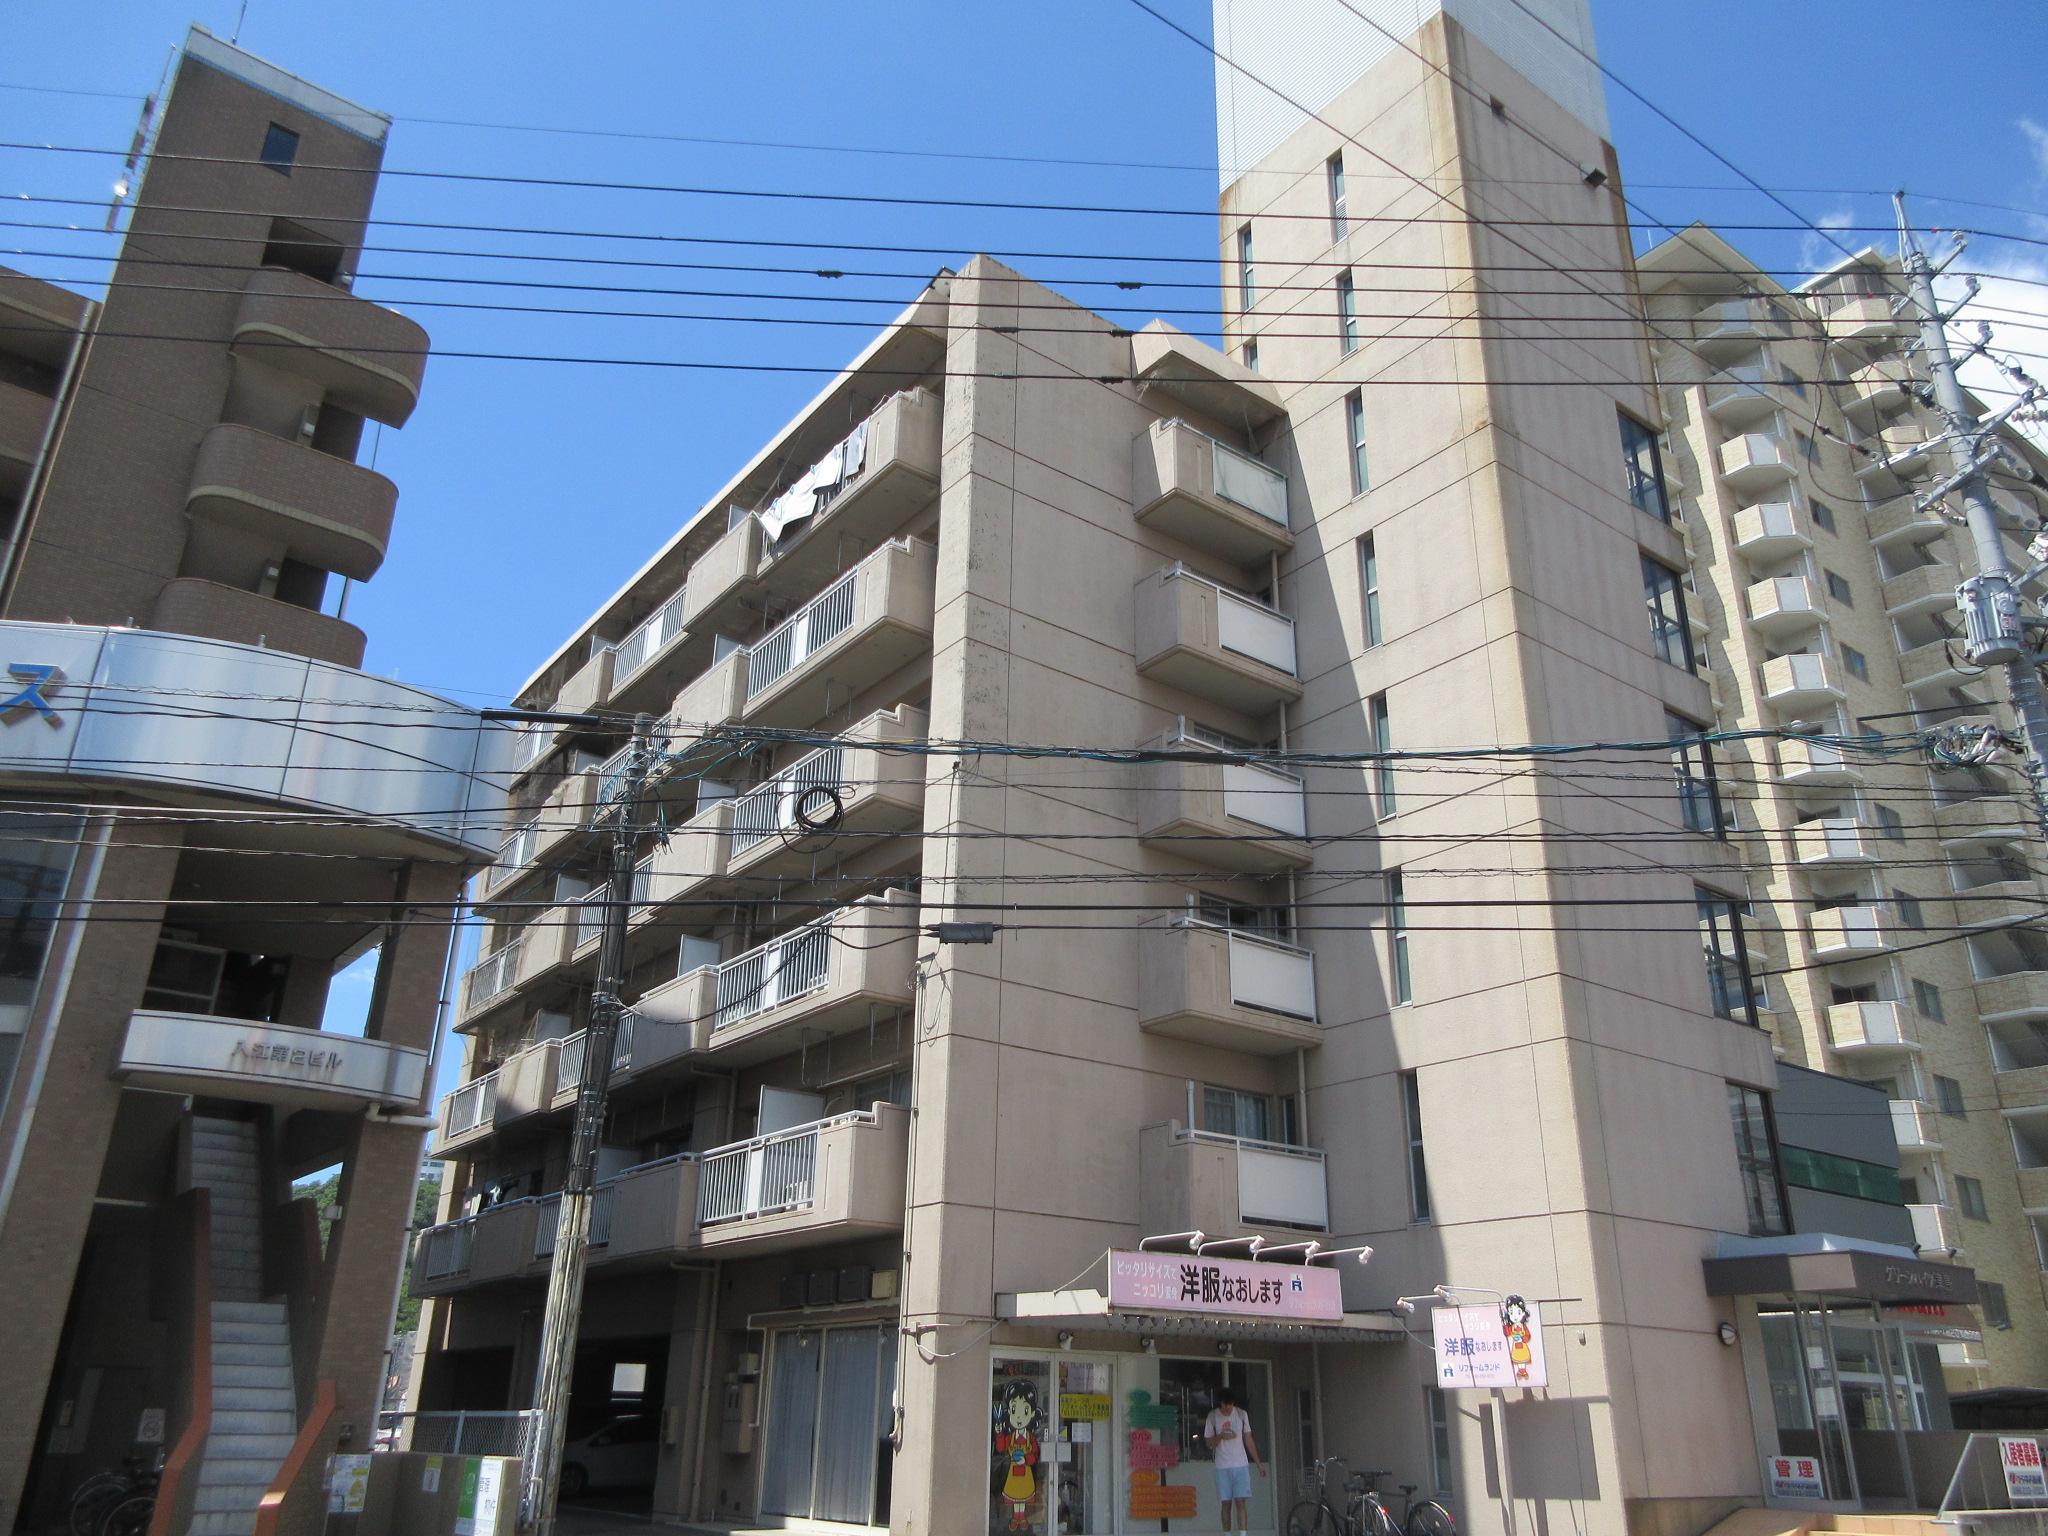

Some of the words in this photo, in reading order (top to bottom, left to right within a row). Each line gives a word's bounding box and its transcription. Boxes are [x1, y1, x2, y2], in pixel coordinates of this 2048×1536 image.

[1180, 1263, 1283, 1305] 洋服なおします
[1444, 1337, 1503, 1356] 洋服なおします
[1775, 1459, 1815, 1478] 管理
